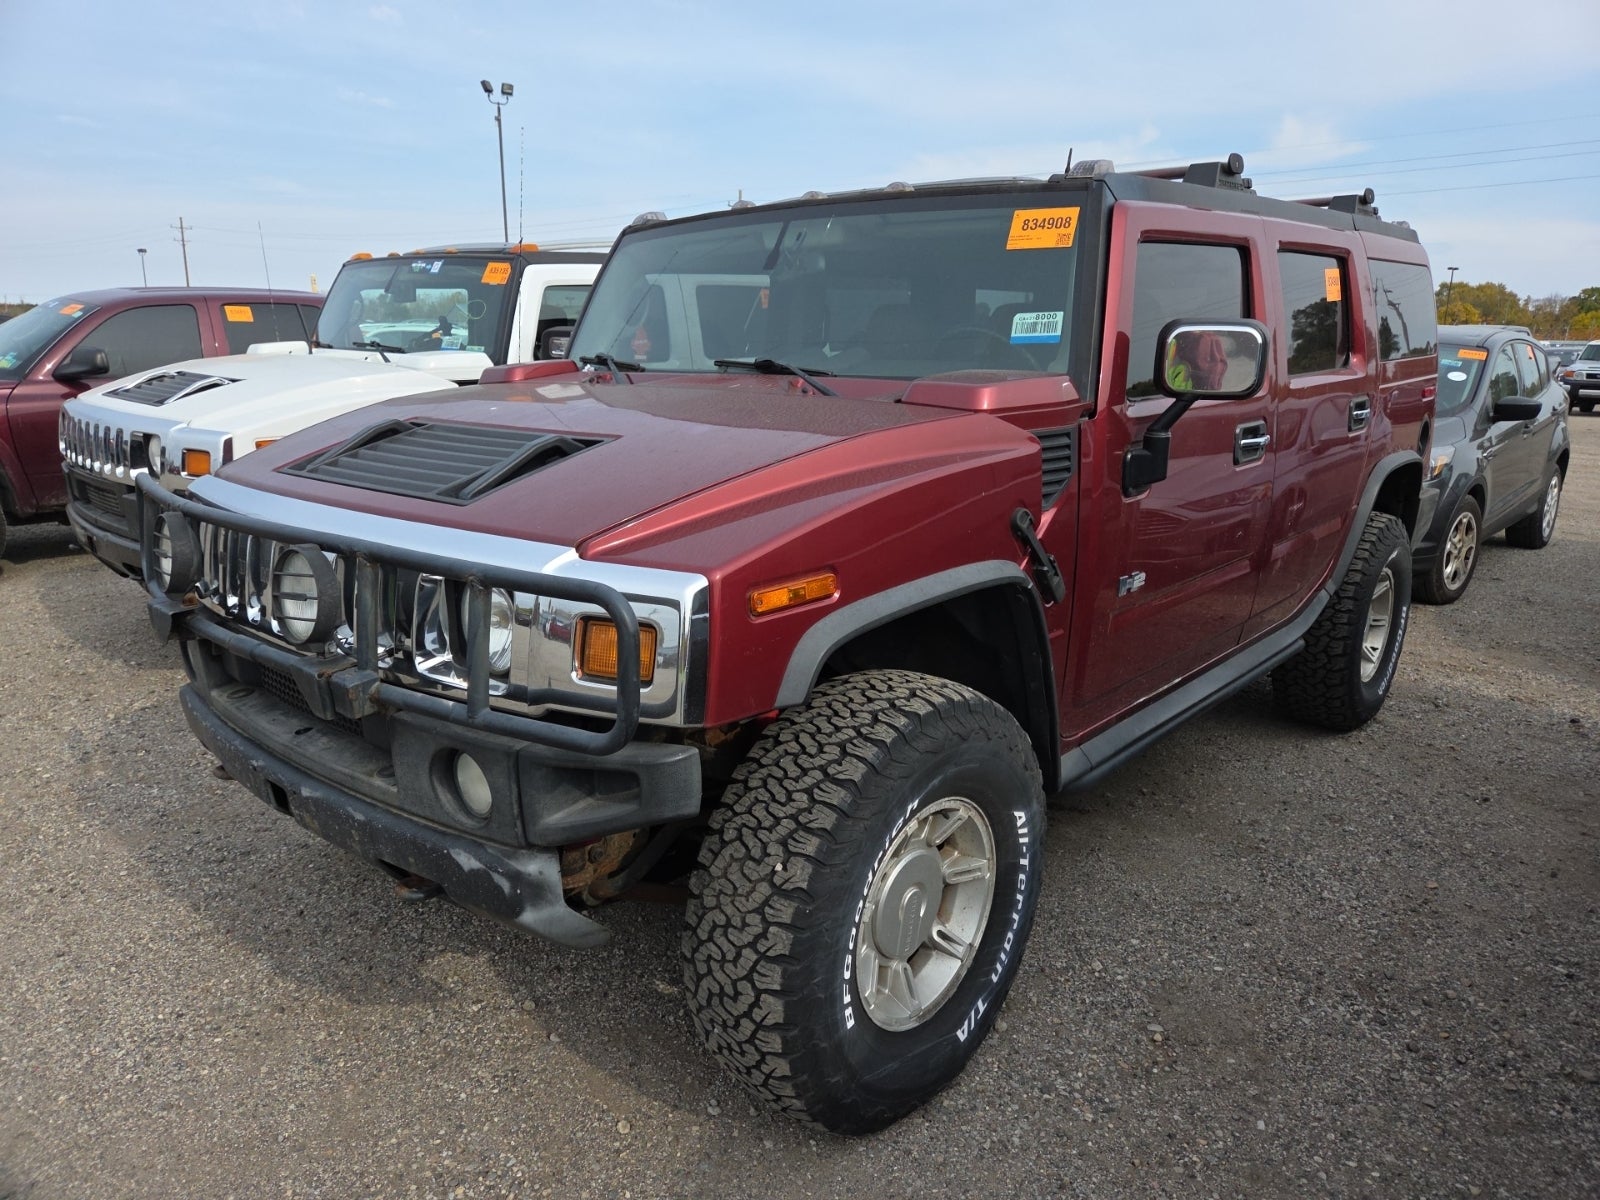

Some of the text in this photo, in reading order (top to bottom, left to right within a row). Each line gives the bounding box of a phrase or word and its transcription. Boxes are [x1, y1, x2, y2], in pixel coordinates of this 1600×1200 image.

[1021, 216, 1072, 232] 834908
[1119, 571, 1146, 597] H2
[955, 810, 1030, 1043] All-Terrain T/A
